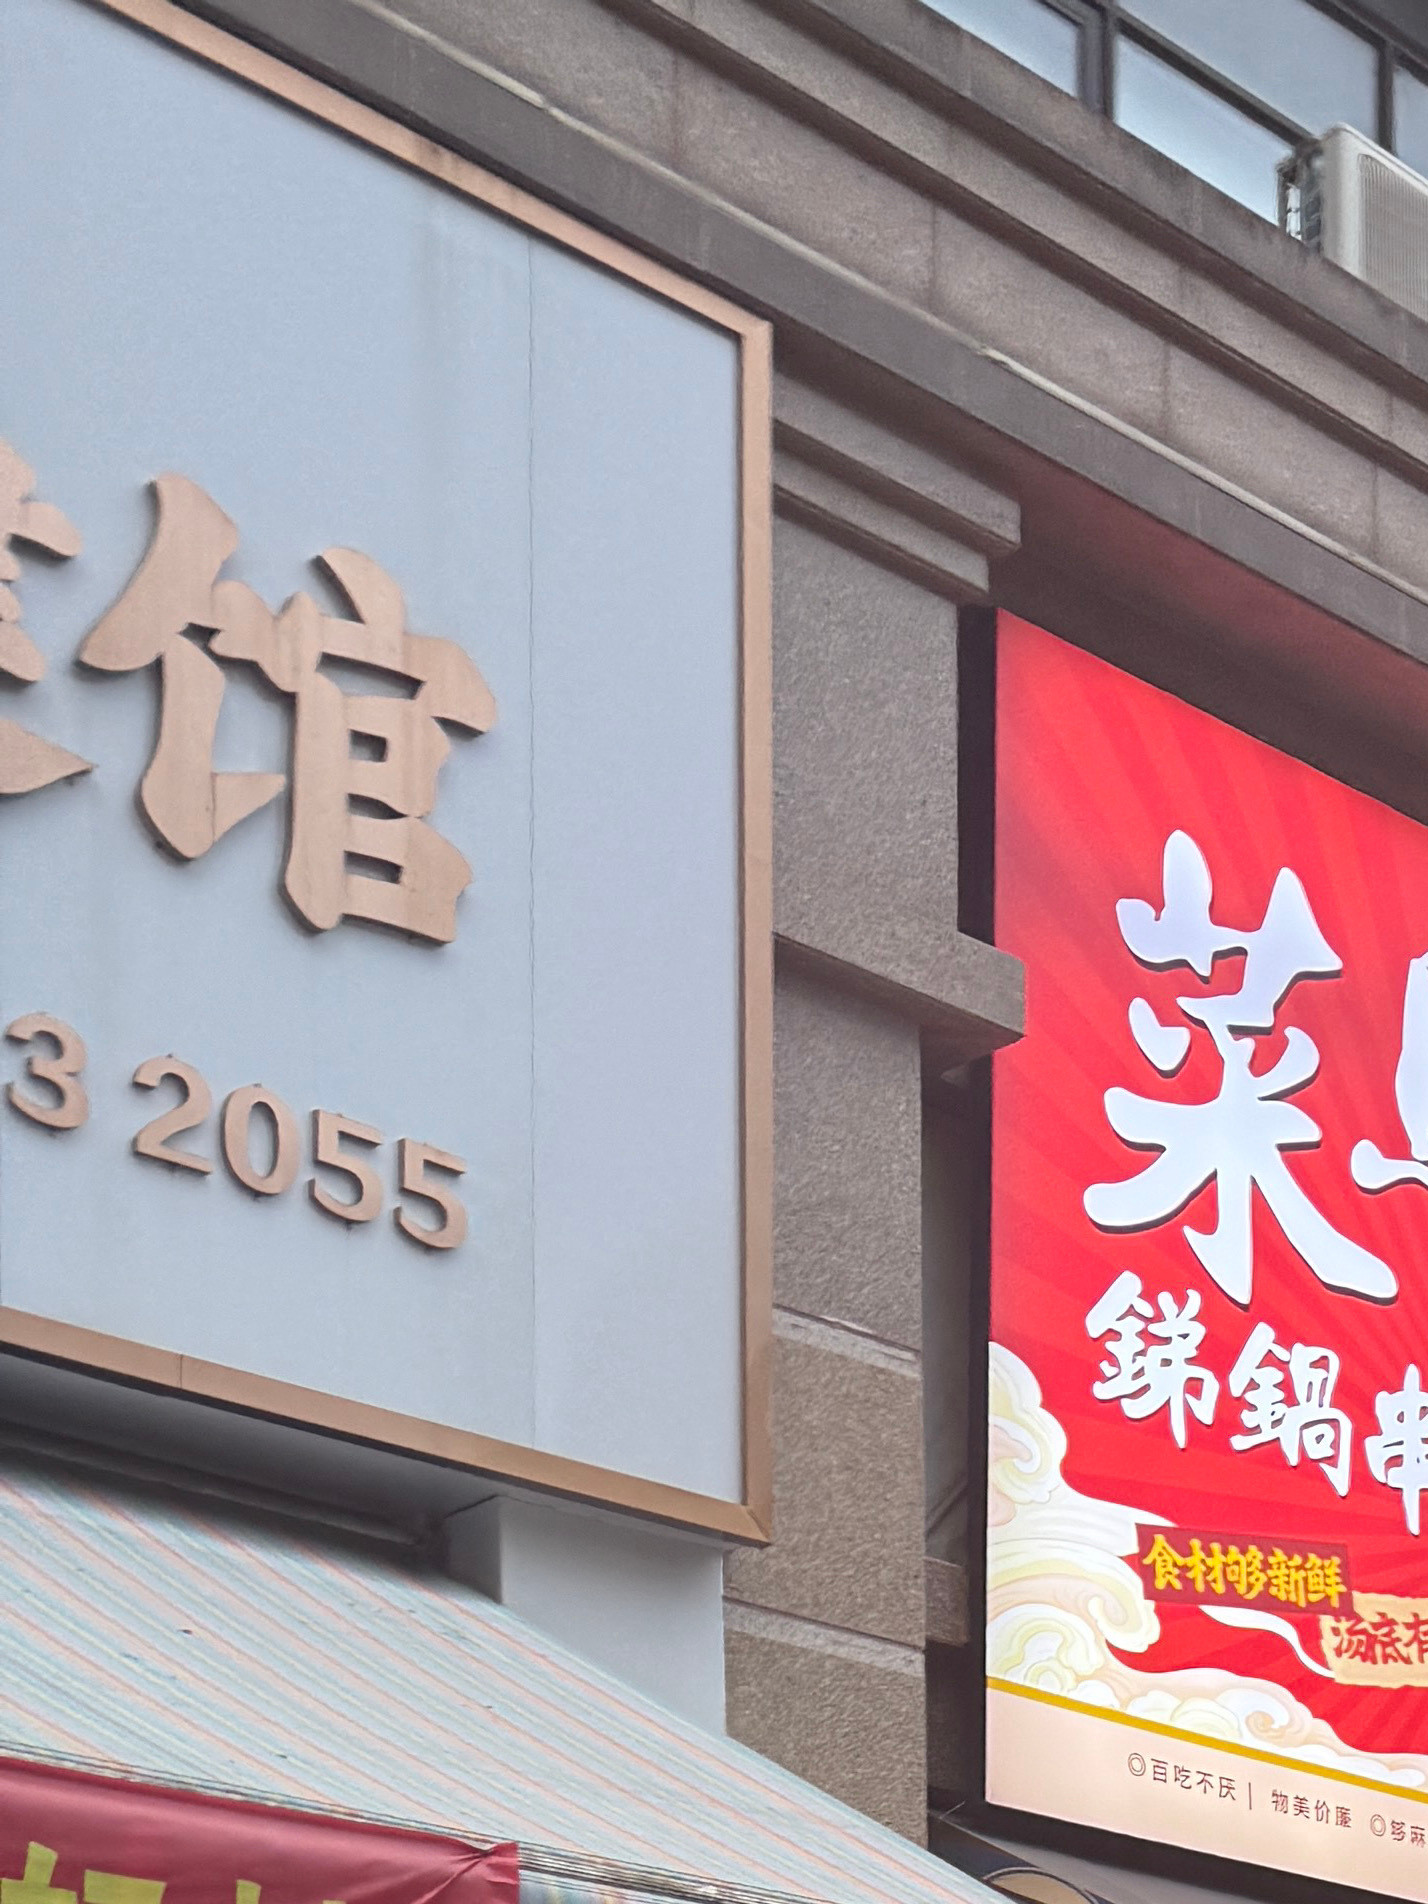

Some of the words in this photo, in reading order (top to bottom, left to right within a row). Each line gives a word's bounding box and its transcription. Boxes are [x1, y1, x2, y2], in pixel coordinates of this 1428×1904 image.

[132, 1054, 469, 1250] 2055
[1143, 1533, 1348, 1609] 食材够新鲜
[1150, 1757, 1238, 1803] 百吃不厌
[1271, 1788, 1353, 1830] 物美价廉
